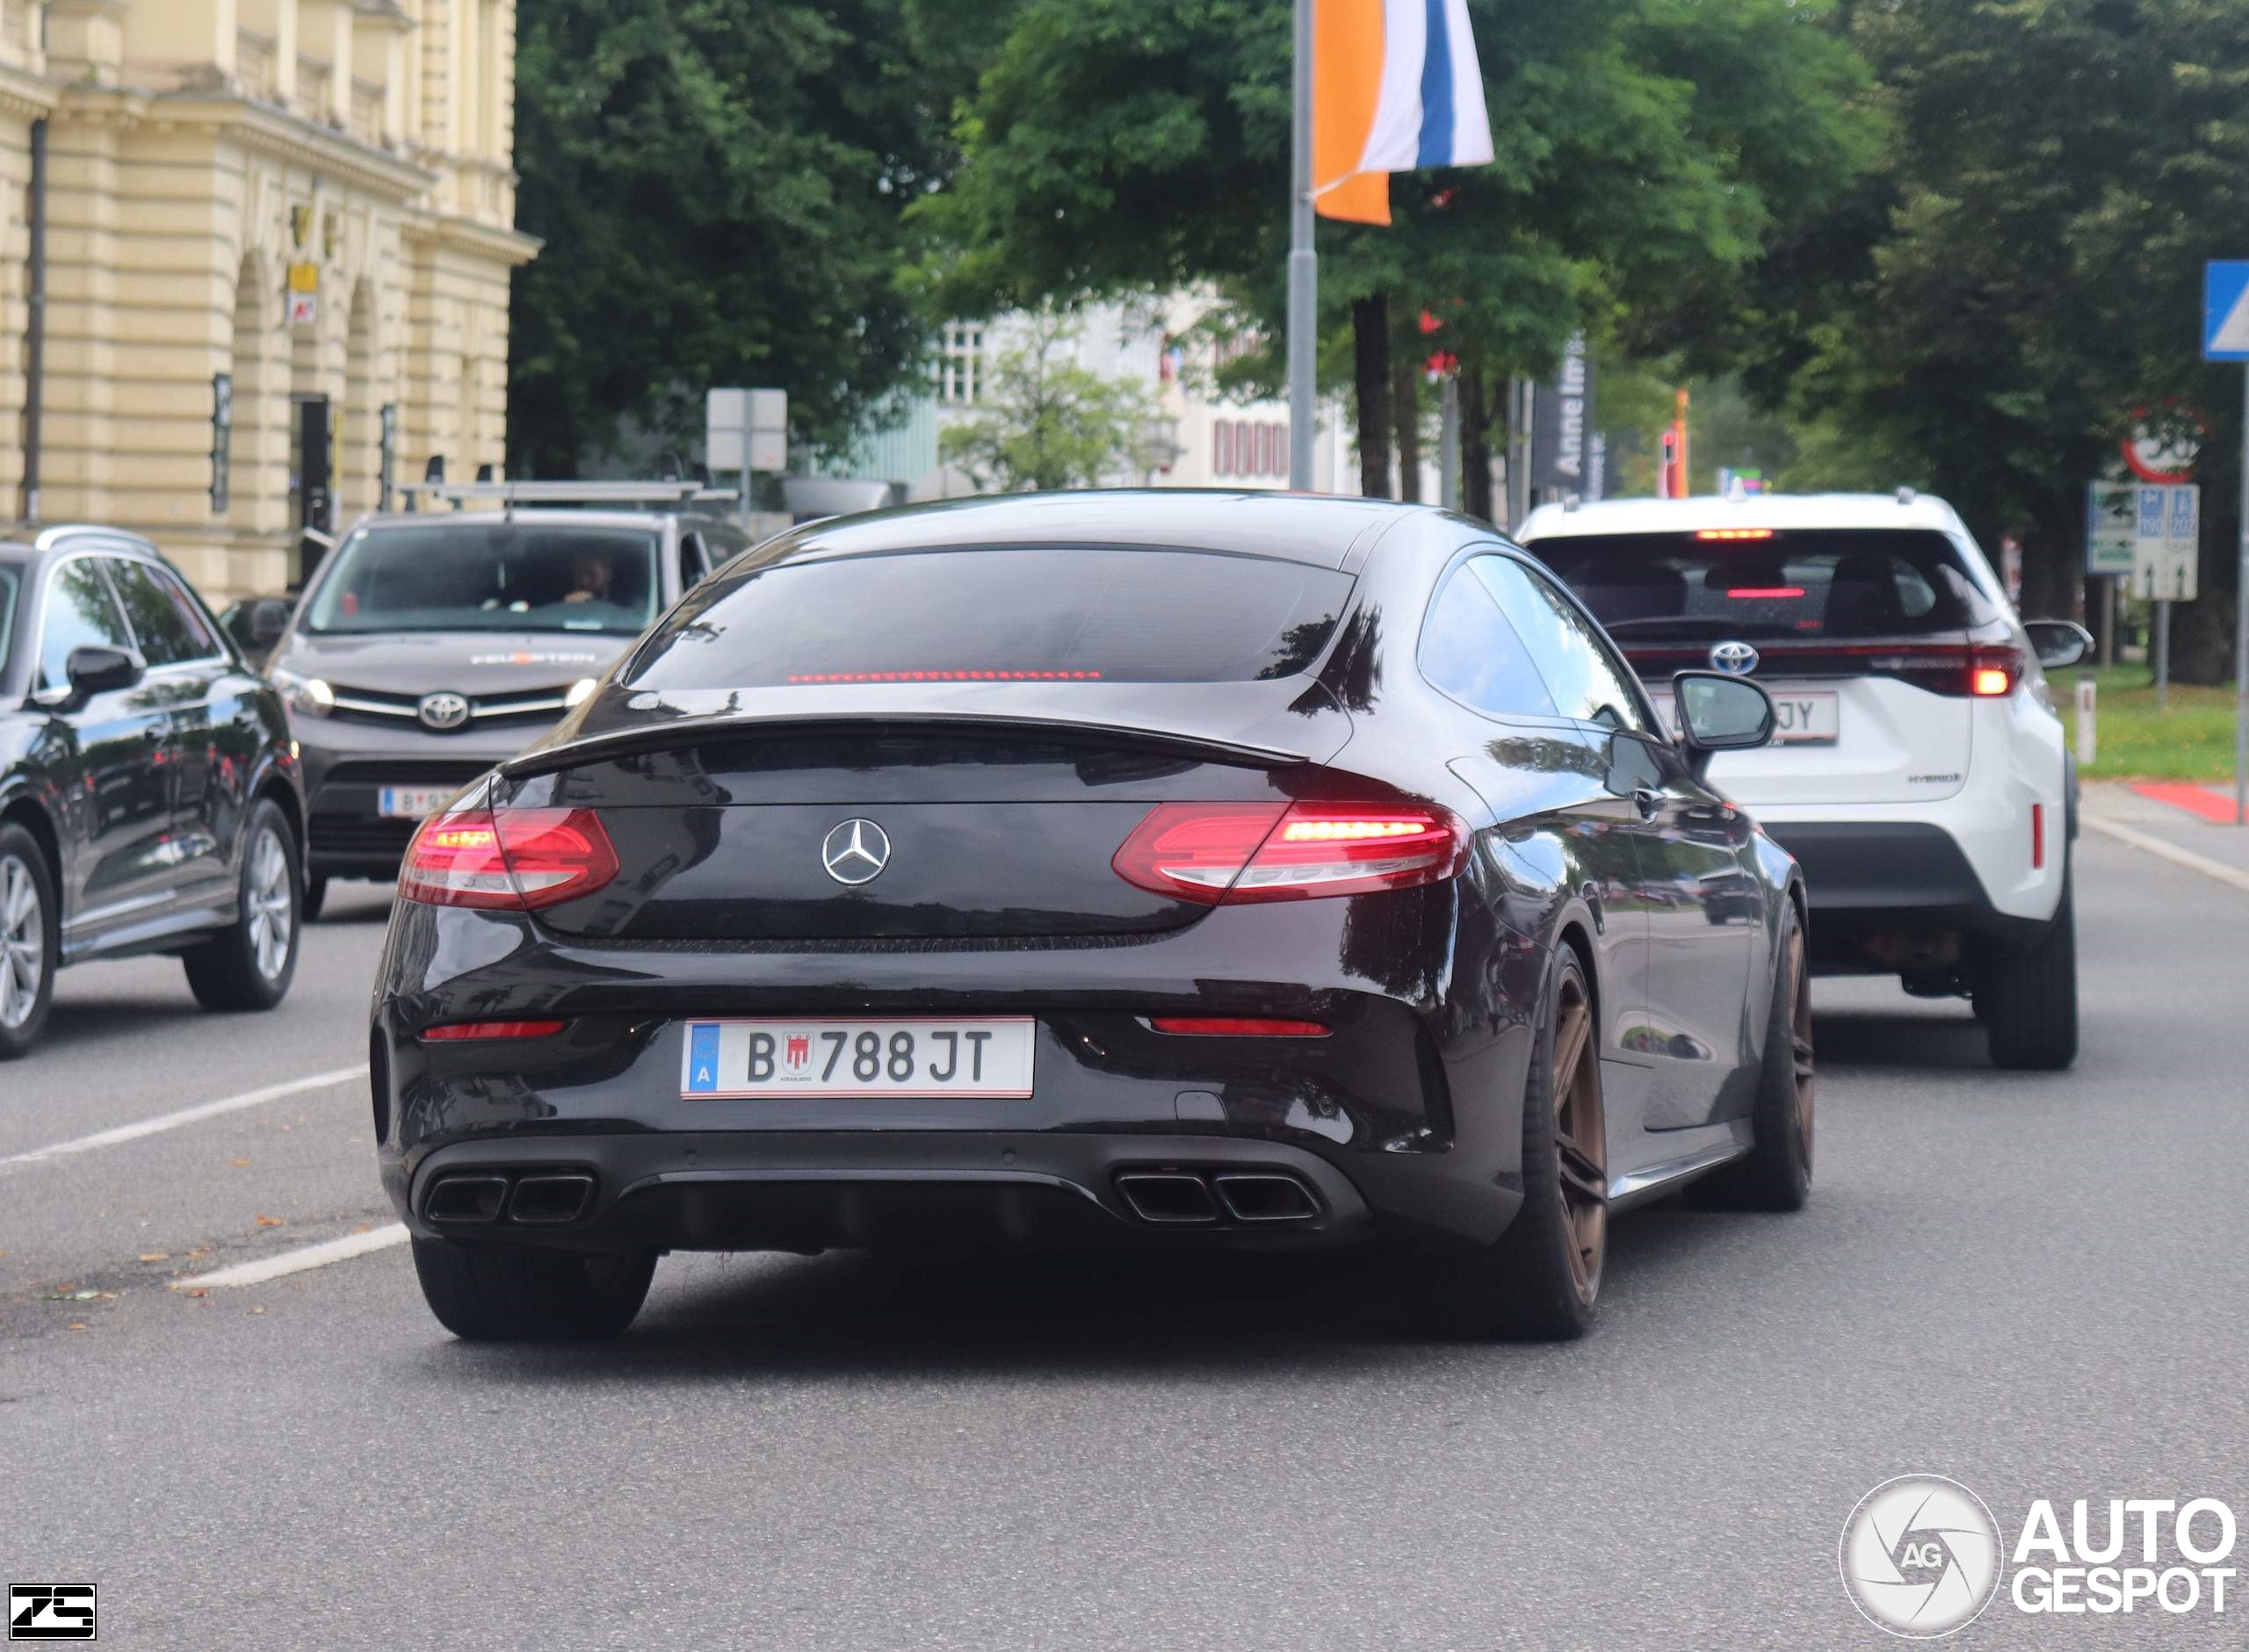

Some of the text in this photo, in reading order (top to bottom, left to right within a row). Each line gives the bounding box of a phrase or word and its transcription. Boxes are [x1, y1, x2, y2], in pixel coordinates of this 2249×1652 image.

[1555, 397, 1584, 477] Anne
[1779, 702, 1814, 730] JY
[697, 1067, 711, 1083] A
[748, 1030, 993, 1083] B 788 JT
